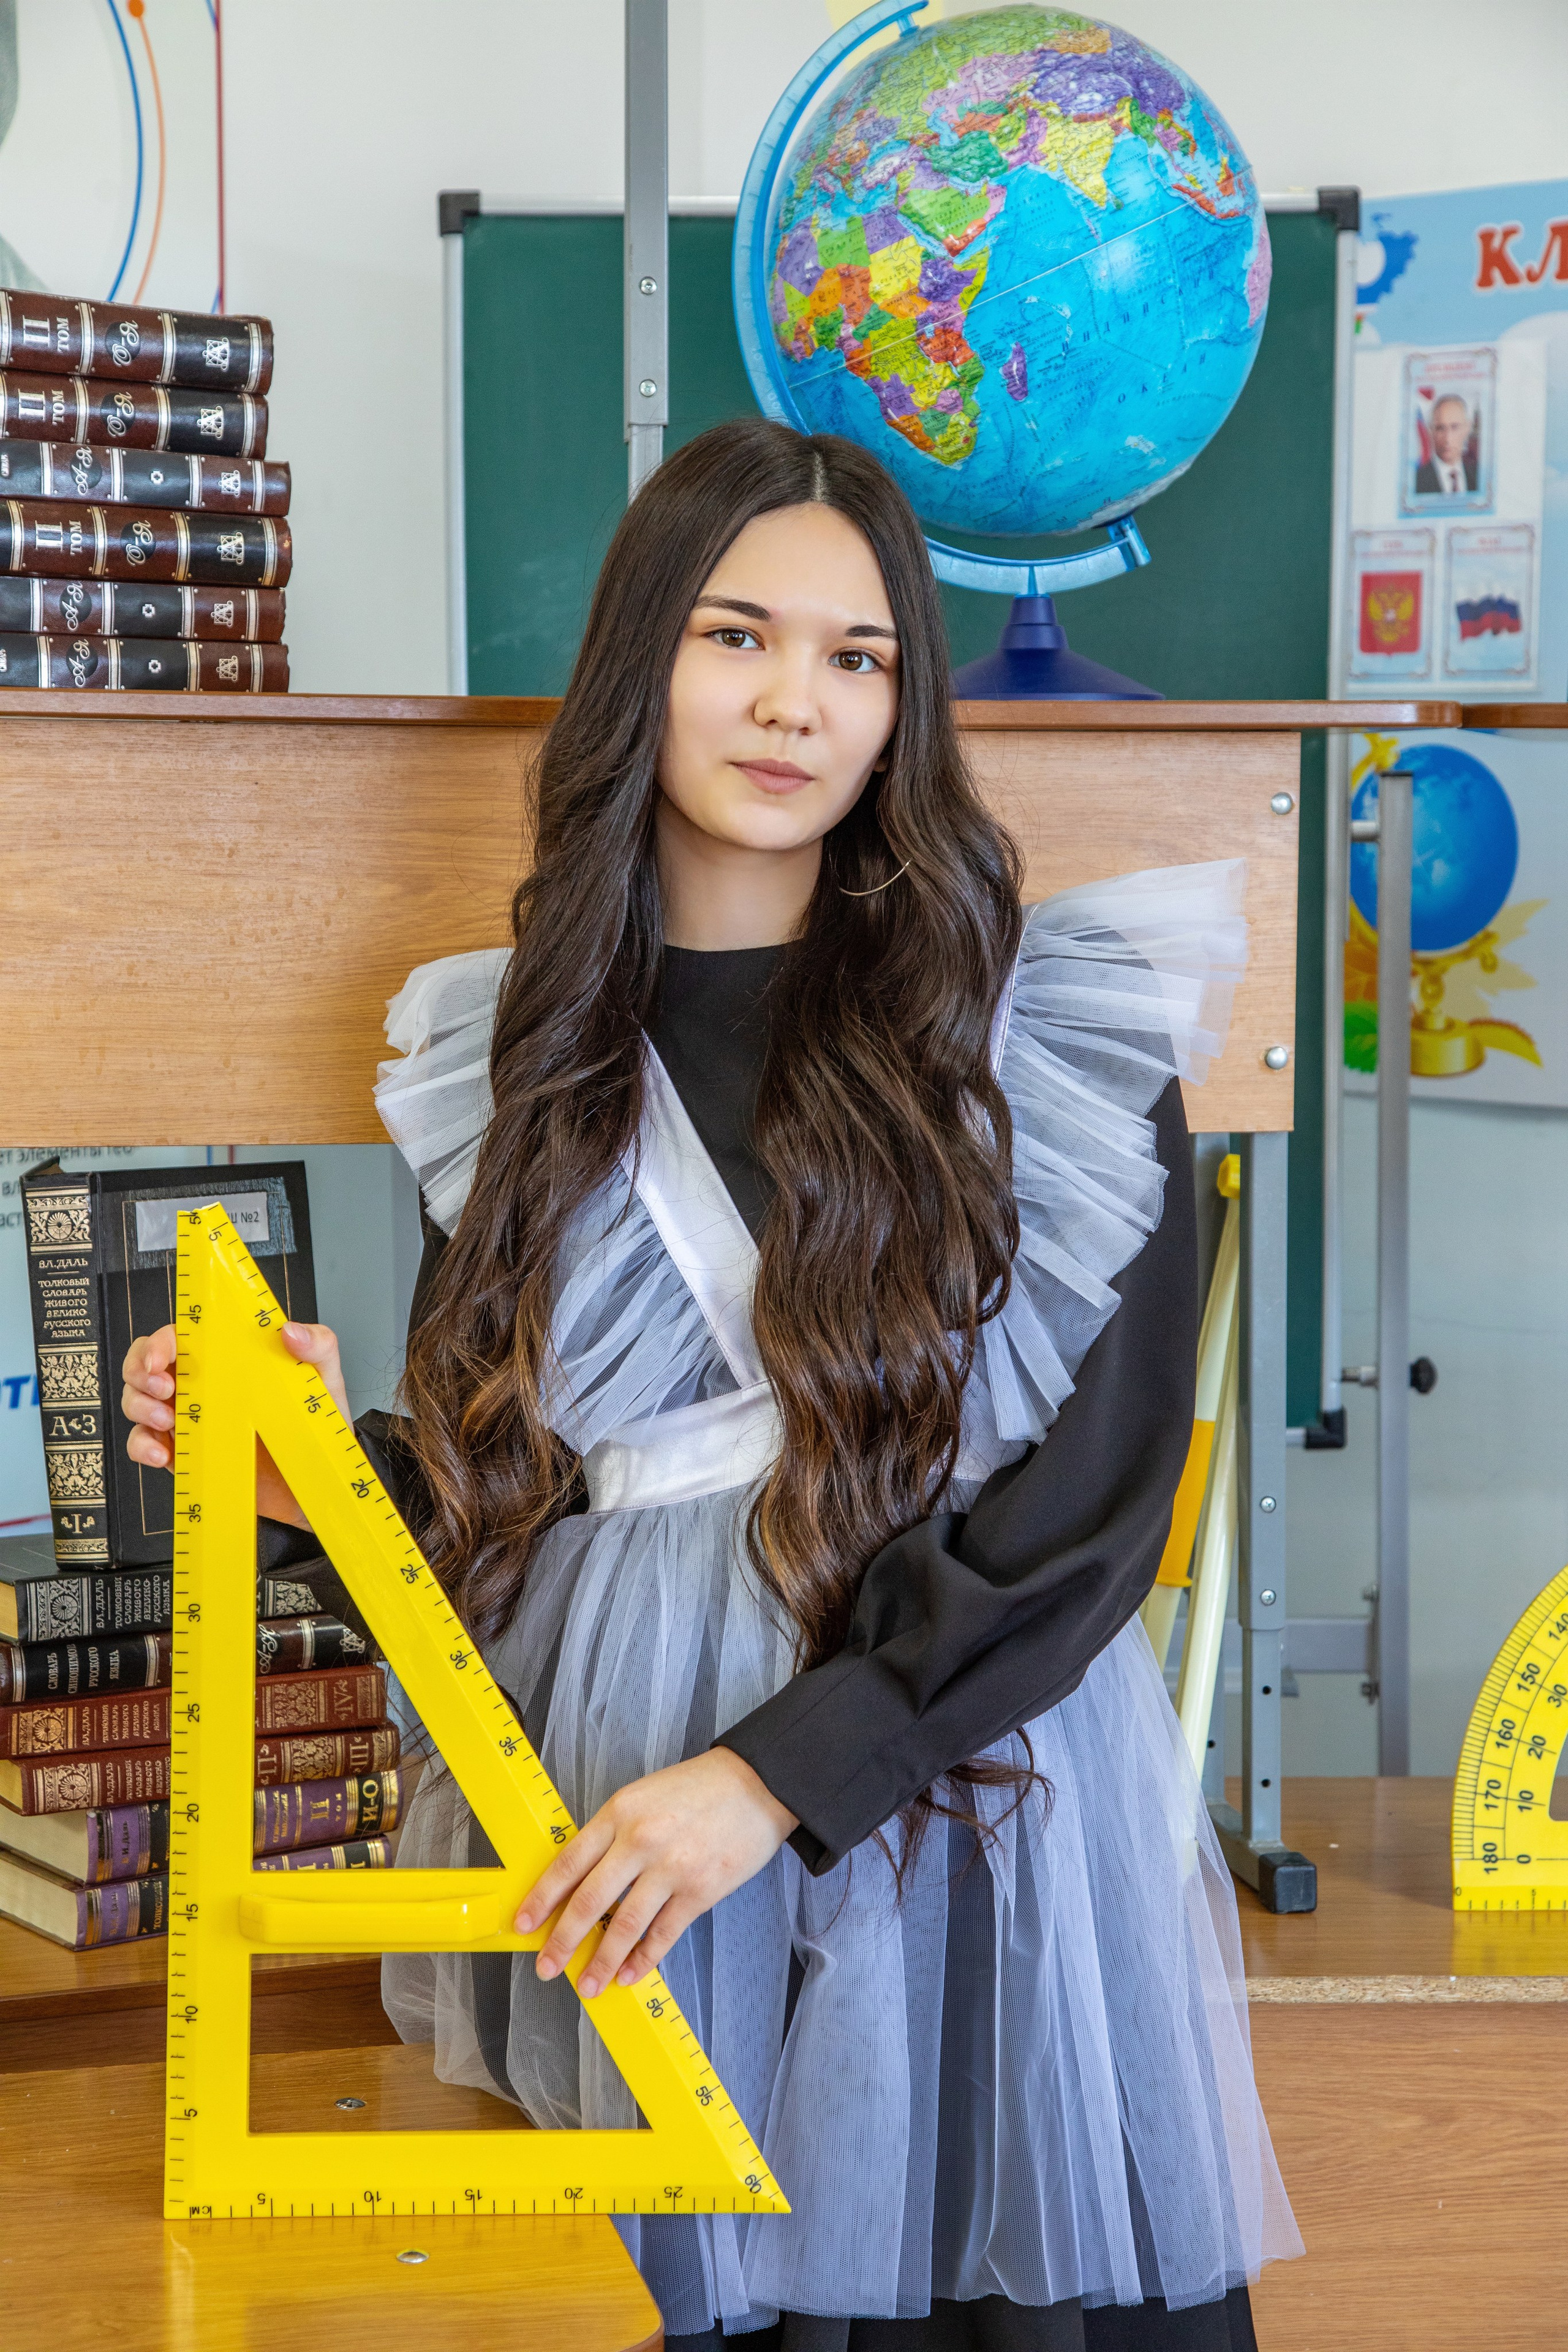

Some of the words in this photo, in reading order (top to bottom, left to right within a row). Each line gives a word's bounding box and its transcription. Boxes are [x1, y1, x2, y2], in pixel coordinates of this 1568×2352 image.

[56, 316, 70, 353] ТОМ
[51, 390, 65, 426] ТОМ
[69, 519, 83, 556] ТОМ
[209, 1231, 222, 1242] 5
[38, 1277, 90, 1287] ТОЛКОВЫЙ
[42, 1288, 88, 1297] СЛОВАРЬ
[44, 1298, 88, 1308] ЖИВОГО
[43, 1319, 91, 1329] РУССКОГО
[189, 1305, 202, 1324] 45
[254, 1309, 271, 1327] 10
[51, 1329, 86, 1338] ЯЗЫКА
[189, 1403, 202, 1423] 40
[304, 1394, 322, 1414] 15
[351, 1479, 370, 1498] 20
[189, 1503, 202, 1523] 35
[401, 1564, 419, 1585] 25
[153, 1575, 162, 1623] РУССКОГО
[189, 1603, 201, 1623] 30
[67, 1643, 79, 1694] СИНОНИМОВ
[88, 1646, 100, 1688] РУССКОГО
[109, 1649, 120, 1680] ЯЗЫКА
[450, 1650, 468, 1670] 30
[47, 1652, 59, 1690] СЛОВАРЬ
[1517, 1663, 1541, 1692] 150
[1547, 1684, 1568, 1708] 30
[187, 1703, 200, 1723] 25
[1495, 1718, 1516, 1749] 160
[499, 1736, 518, 1757] 35
[1528, 1735, 1547, 1760] 20
[1484, 1779, 1502, 1811] 170
[1518, 1790, 1534, 1812] 10
[187, 1803, 200, 1823] 20
[550, 1825, 567, 1844] 40
[1482, 1842, 1499, 1874] 180
[1517, 1854, 1531, 1864] 0
[187, 1904, 199, 1923] 15
[185, 2005, 198, 2024] 10
[646, 1997, 664, 2019] 50
[695, 2085, 714, 2107] 55
[184, 2108, 198, 2117] 5
[744, 2174, 762, 2195] 60
[257, 2193, 265, 2205] 5
[364, 2190, 382, 2203] 10
[465, 2188, 483, 2201] 15
[565, 2187, 583, 2199] 20
[664, 2186, 683, 2198] 25
